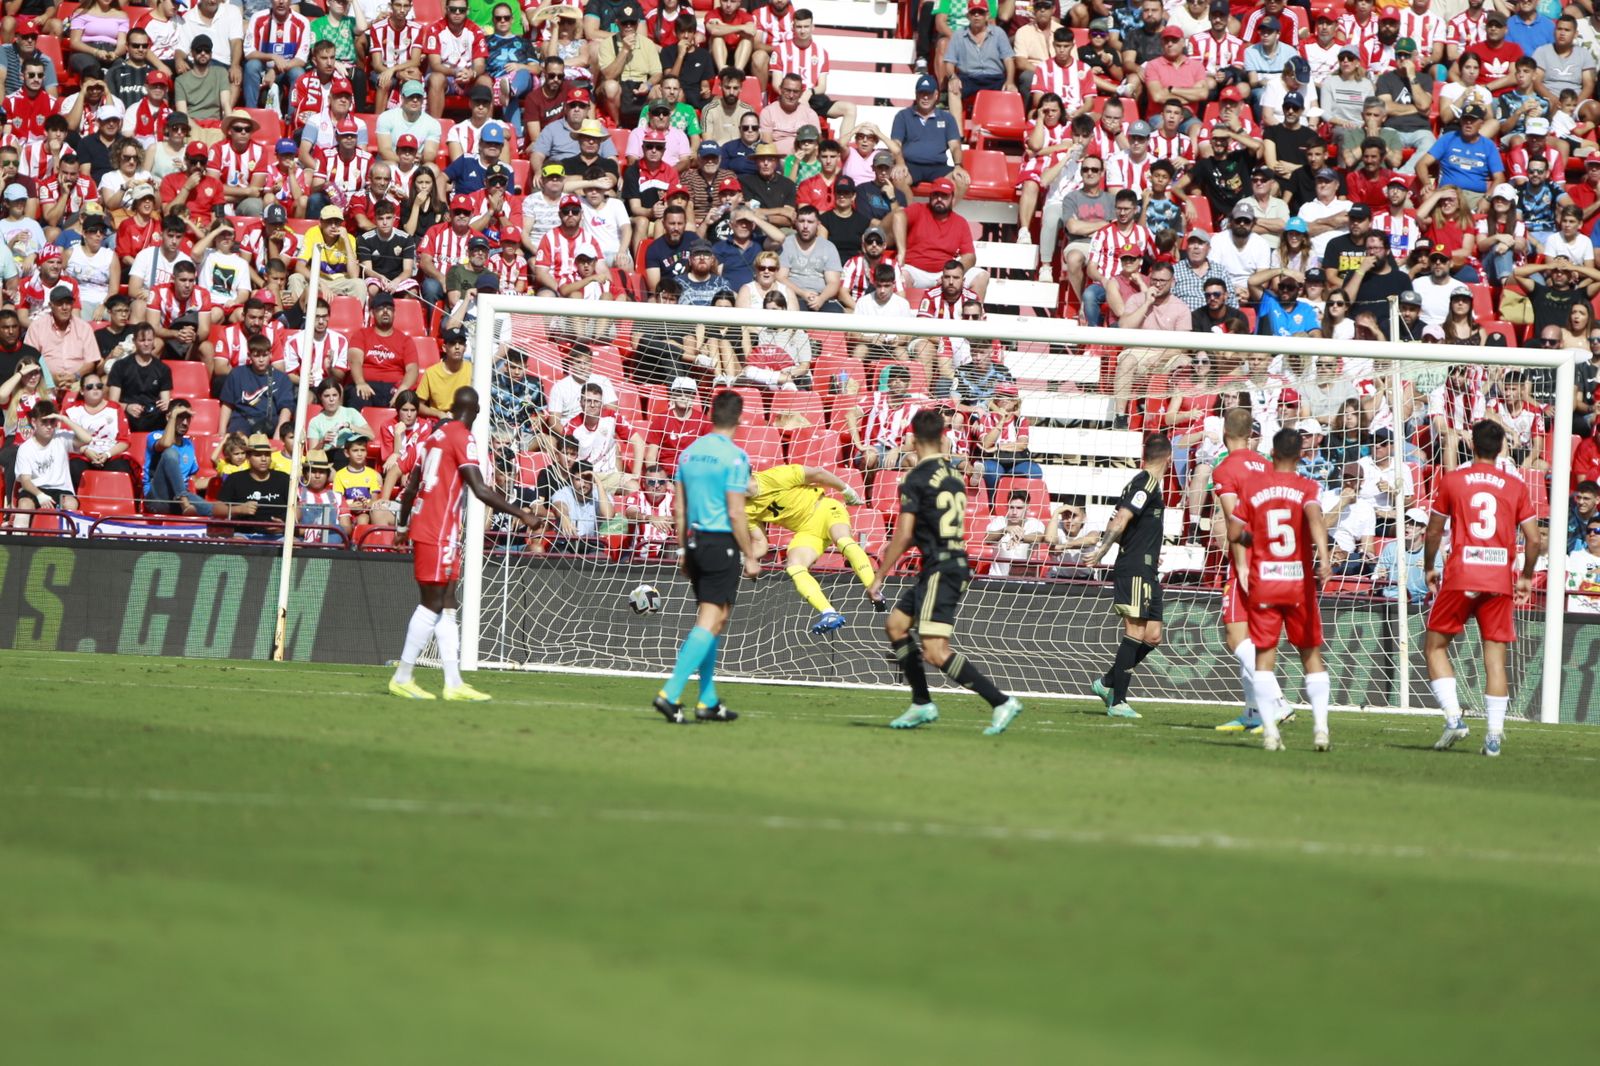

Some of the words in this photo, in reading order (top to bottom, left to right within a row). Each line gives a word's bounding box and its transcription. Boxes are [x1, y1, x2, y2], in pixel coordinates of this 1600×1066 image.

[1464, 472, 1506, 489] MELERO
[1266, 508, 1297, 558] 5
[1470, 491, 1497, 540] 3
[0, 544, 333, 663] S.COM
